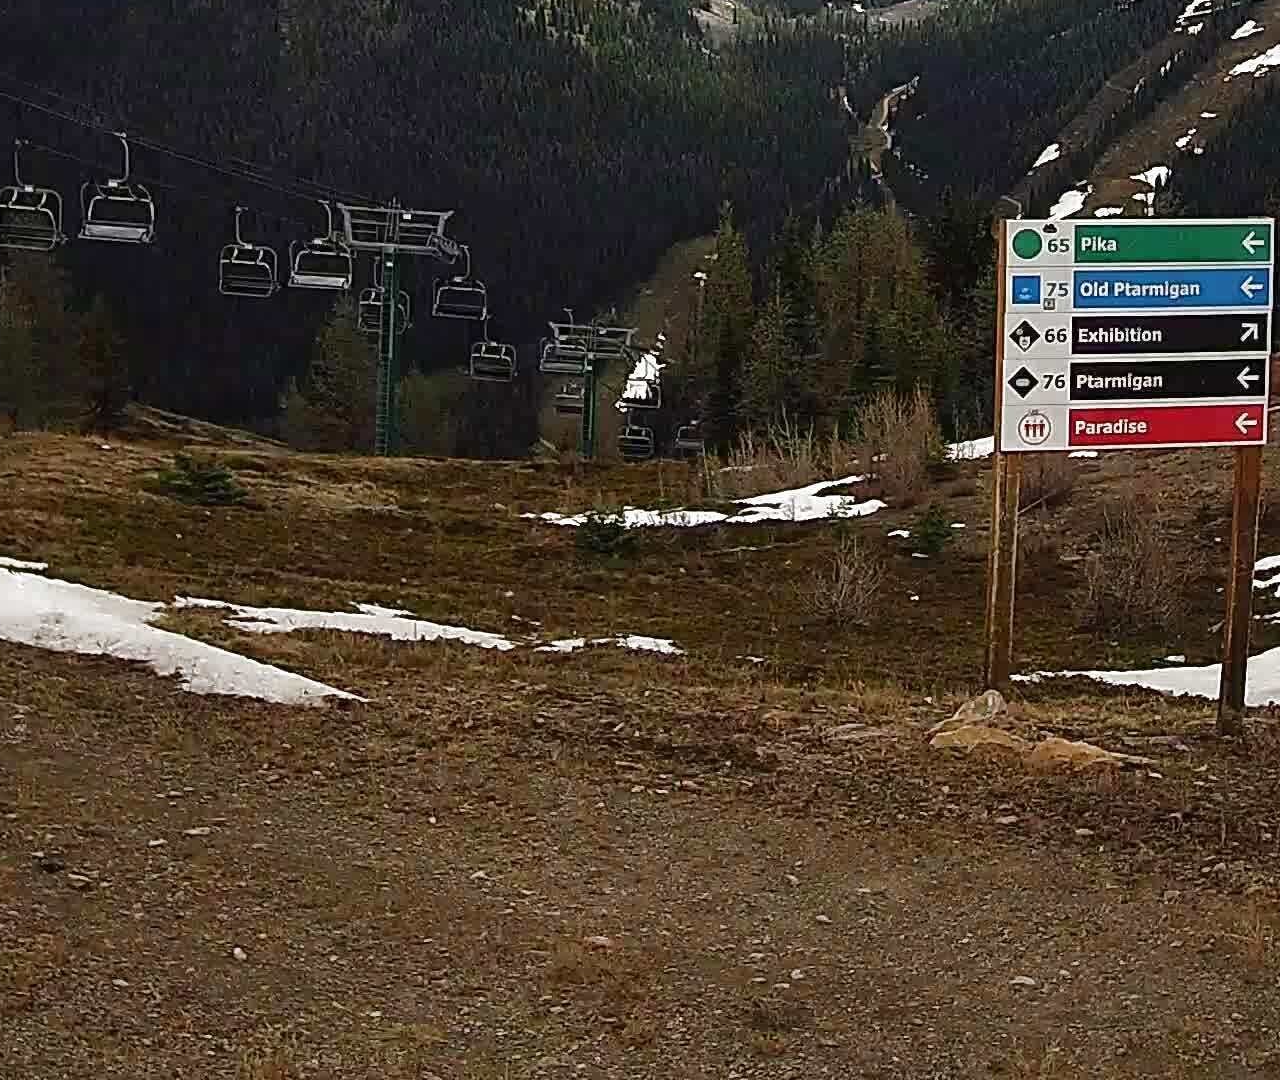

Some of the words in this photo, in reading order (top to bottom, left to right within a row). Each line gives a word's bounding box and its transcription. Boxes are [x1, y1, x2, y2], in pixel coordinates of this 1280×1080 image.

[1046, 238, 1070, 253] 65
[1080, 235, 1117, 252] Pika
[1046, 282, 1069, 297] 75
[1079, 281, 1109, 297] Old
[1114, 280, 1201, 299] Ptarmigan
[1044, 328, 1068, 344] 66
[1078, 327, 1162, 343] Exhibition
[1042, 374, 1066, 390] 76
[1076, 372, 1163, 391] Ptarmigan
[1074, 419, 1148, 435] Paradise
